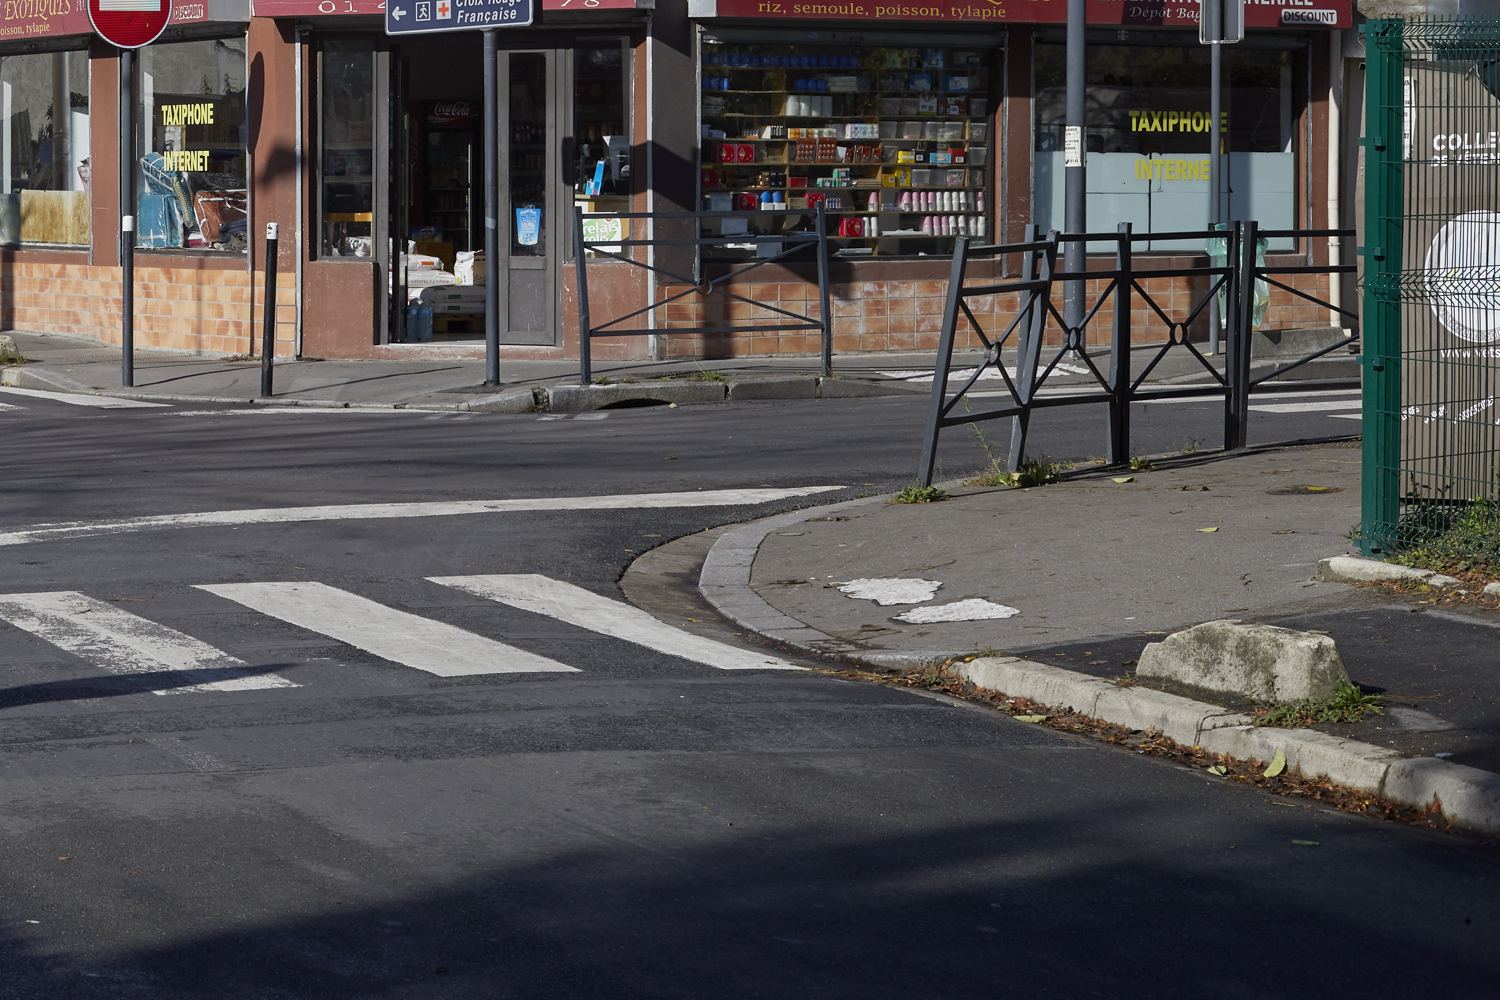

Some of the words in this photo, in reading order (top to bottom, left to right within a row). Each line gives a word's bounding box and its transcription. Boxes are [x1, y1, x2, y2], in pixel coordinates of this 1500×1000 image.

[457, 8, 517, 24] Française
[758, 1, 787, 14] riz,
[793, 2, 869, 16] semoule,
[875, 4, 944, 18] poisson,
[951, 5, 1006, 19] tylapie
[1129, 6, 1172, 21] Dépôt
[1283, 11, 1335, 22] DISCOUNT
[26, 22, 51, 36] tylapie
[161, 103, 214, 126] TAXIPHONE
[1433, 131, 1500, 151] COLLE
[163, 150, 210, 172] INTERNET
[1431, 154, 1448, 168] DE
[1135, 159, 1211, 181] INTERNE
[583, 221, 618, 235] relais
